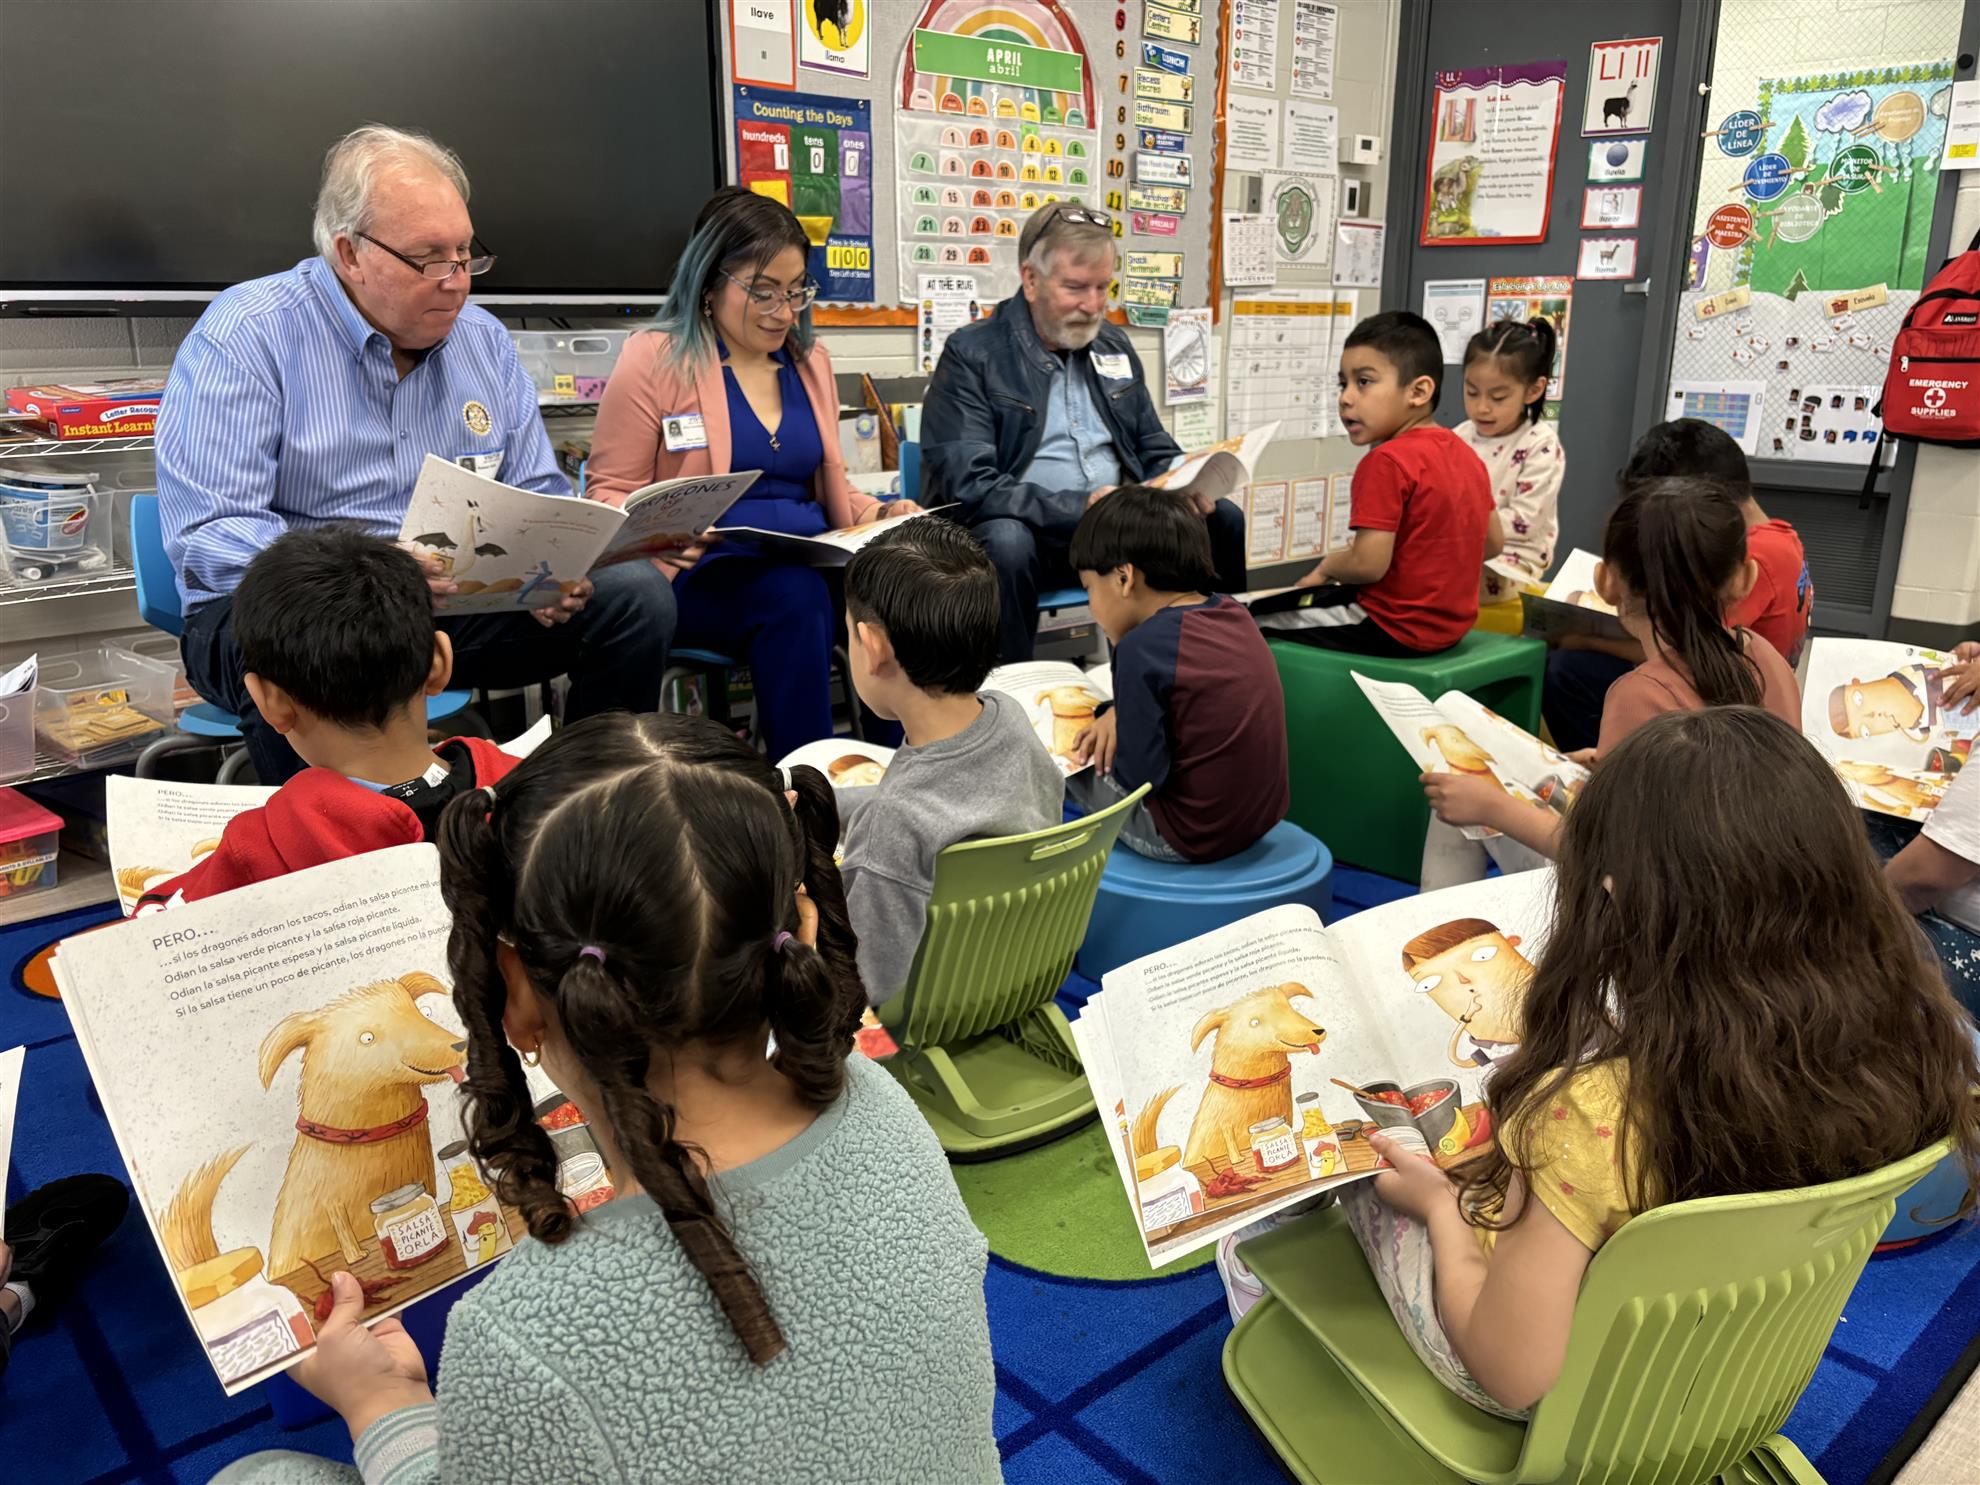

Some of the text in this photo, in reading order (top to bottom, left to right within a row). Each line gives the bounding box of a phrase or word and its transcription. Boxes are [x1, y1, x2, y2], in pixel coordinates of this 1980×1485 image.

[750, 7, 774, 20] llave
[986, 48, 1023, 66] APRIL
[1116, 40, 1125, 58] 6
[989, 63, 1020, 77] abril
[1120, 75, 1128, 93] 7
[753, 102, 853, 128] Counting the Days
[1118, 106, 1125, 123] 8
[1728, 118, 1755, 129] LÍDER
[742, 129, 786, 144] hundreds
[804, 136, 824, 147] tens
[1116, 133, 1125, 150] 9
[1735, 130, 1747, 138] DE
[843, 139, 865, 150] ones
[950, 132, 1079, 155] 1 2 3 4 5 6
[1727, 139, 1753, 150] LÍNEA
[813, 152, 821, 169] 0
[848, 155, 857, 172] 0
[919, 157, 1083, 182] 7 8 9 10 11 12 13
[1108, 160, 1124, 178] 10
[1751, 177, 1787, 185] OVIMIENTO
[920, 190, 930, 201] 14
[948, 192, 957, 203] 15
[1001, 194, 1011, 206] 17
[1026, 196, 1034, 207] 18
[1107, 192, 1122, 210] 11
[922, 220, 1012, 234] 21 22 23 24
[1716, 214, 1748, 223] ASISTENTE
[1714, 229, 1742, 239] MAESTRA
[946, 250, 957, 261] 29
[927, 279, 973, 290] AT THE RUG
[1908, 378, 1968, 389] EMERGENCY
[105, 405, 160, 419] Letter Recogn
[1910, 406, 1956, 417] SUPPLIES
[63, 418, 156, 437] Instant Learni
[183, 949, 199, 961] los
[201, 934, 249, 955] dragones
[251, 923, 285, 939] adoran
[286, 917, 301, 928] los
[303, 909, 332, 923] tacos,
[332, 899, 359, 914] odian
[359, 895, 368, 906] la
[369, 890, 390, 903] salsa
[391, 884, 419, 898] picante
[420, 880, 430, 890] mil
[152, 927, 214, 951] PERO...
[164, 906, 401, 984] Odian la salsa verde picante y la salsa roja picante.
[170, 915, 422, 1001] Odian la salsa picante espesa y la salsa picante líquida.
[176, 923, 452, 1018] Si la salsa tiene un poco de picante, los dragones no la puede
[1265, 1137, 1289, 1150] SALSA
[1266, 1144, 1291, 1158] PICANTE
[1269, 1150, 1294, 1165] ORLA
[398, 1214, 432, 1235] SALSA
[401, 1223, 435, 1245] PICANTE
[404, 1230, 440, 1256] ORLA
